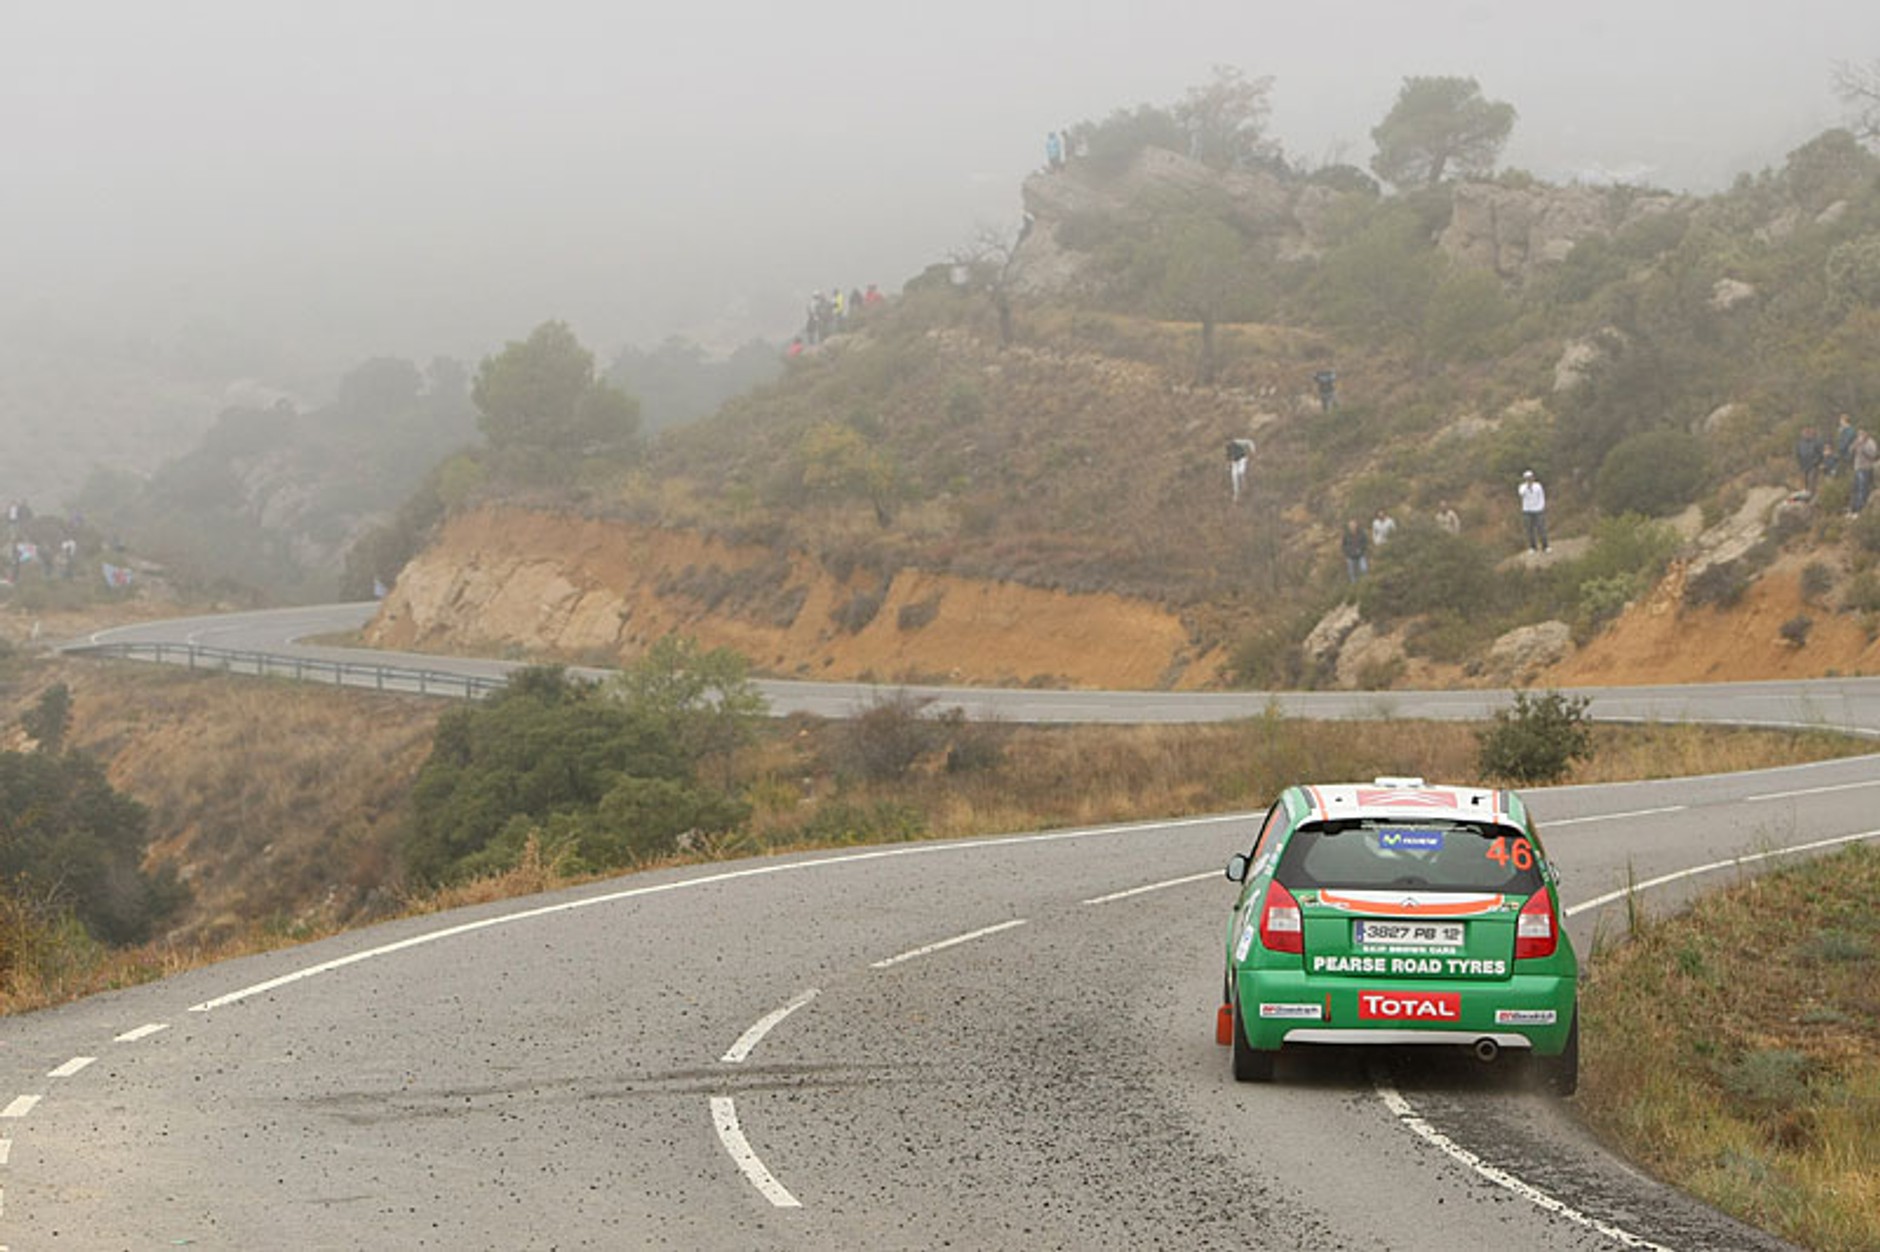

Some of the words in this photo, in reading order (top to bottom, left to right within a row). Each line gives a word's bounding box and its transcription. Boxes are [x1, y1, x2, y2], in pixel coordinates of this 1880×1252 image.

[1486, 836, 1533, 870] 46
[1367, 925, 1410, 939] 3827
[1313, 956, 1387, 972] PEARSE
[1391, 958, 1442, 973] ROAD
[1446, 959, 1506, 974] TYRES
